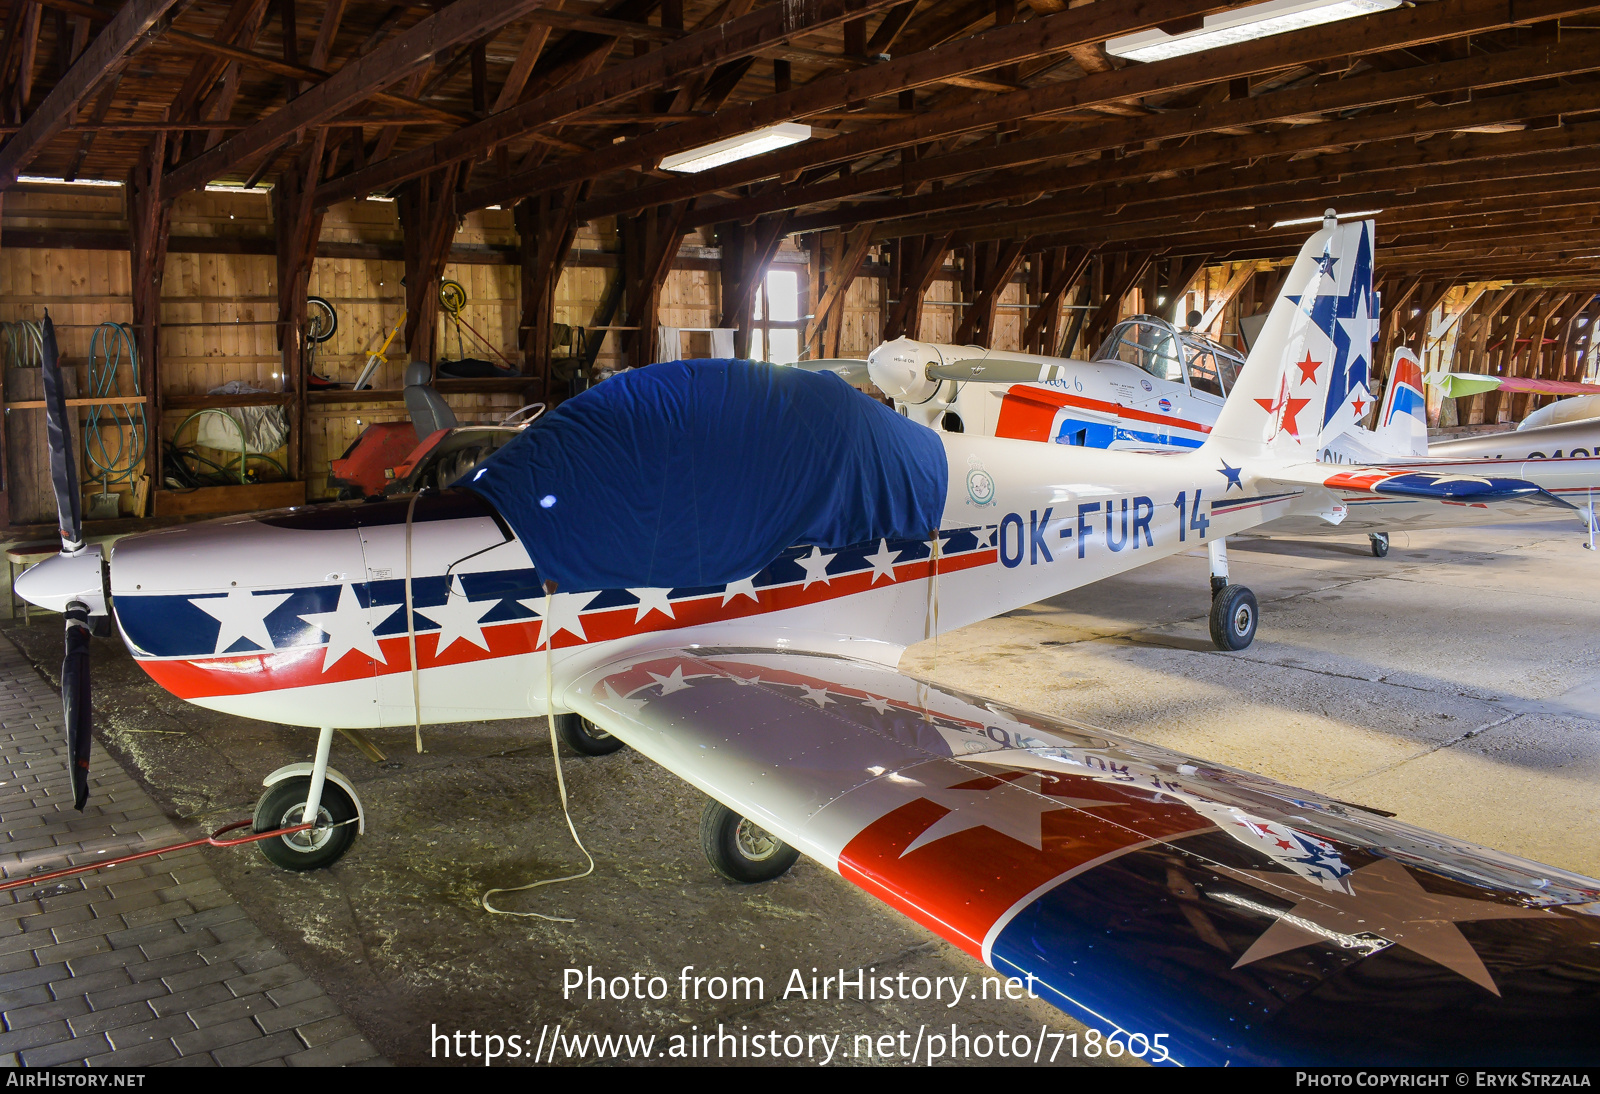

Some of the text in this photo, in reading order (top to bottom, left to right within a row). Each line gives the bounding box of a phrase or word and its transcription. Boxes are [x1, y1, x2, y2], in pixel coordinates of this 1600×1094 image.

[1074, 375, 1083, 392] 6
[1000, 489, 1210, 568] OK-FUR 14
